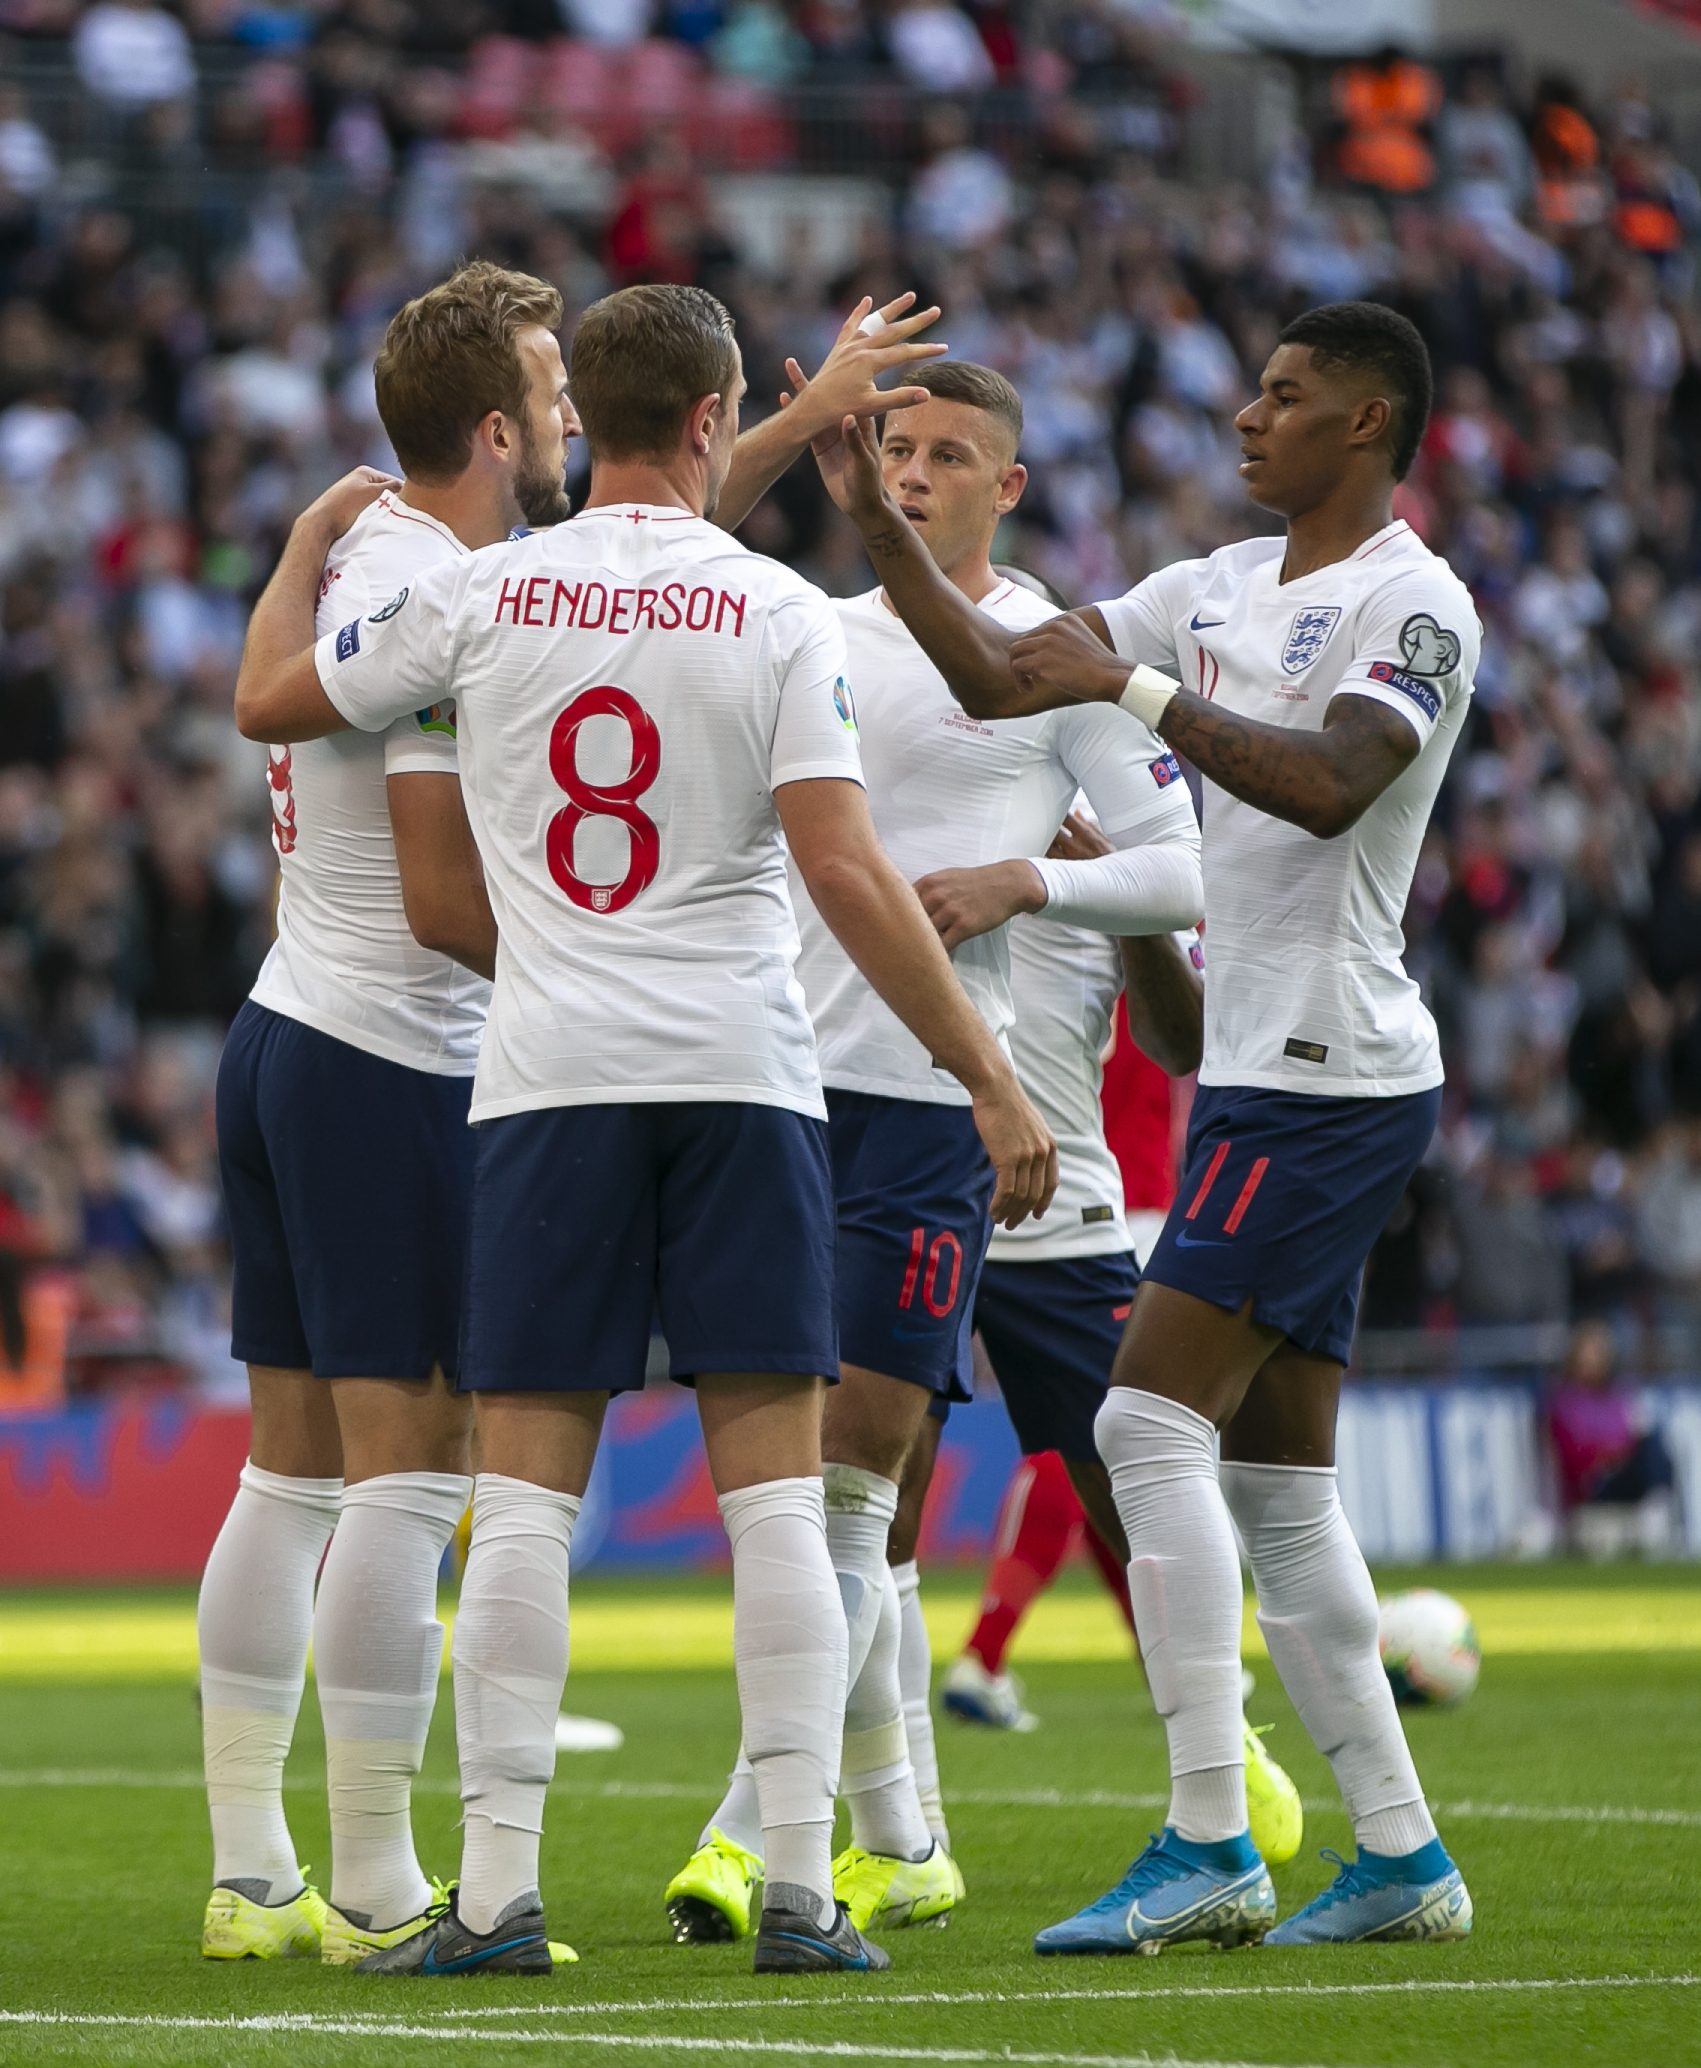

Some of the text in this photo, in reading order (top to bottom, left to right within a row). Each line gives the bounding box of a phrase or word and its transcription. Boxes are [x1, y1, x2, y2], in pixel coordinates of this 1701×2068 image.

[495, 577, 746, 637] HENDERSON
[1392, 672, 1439, 715] RESPECT
[546, 685, 661, 914] 8
[1185, 1141, 1270, 1235] 11
[899, 1227, 963, 1318] 10
